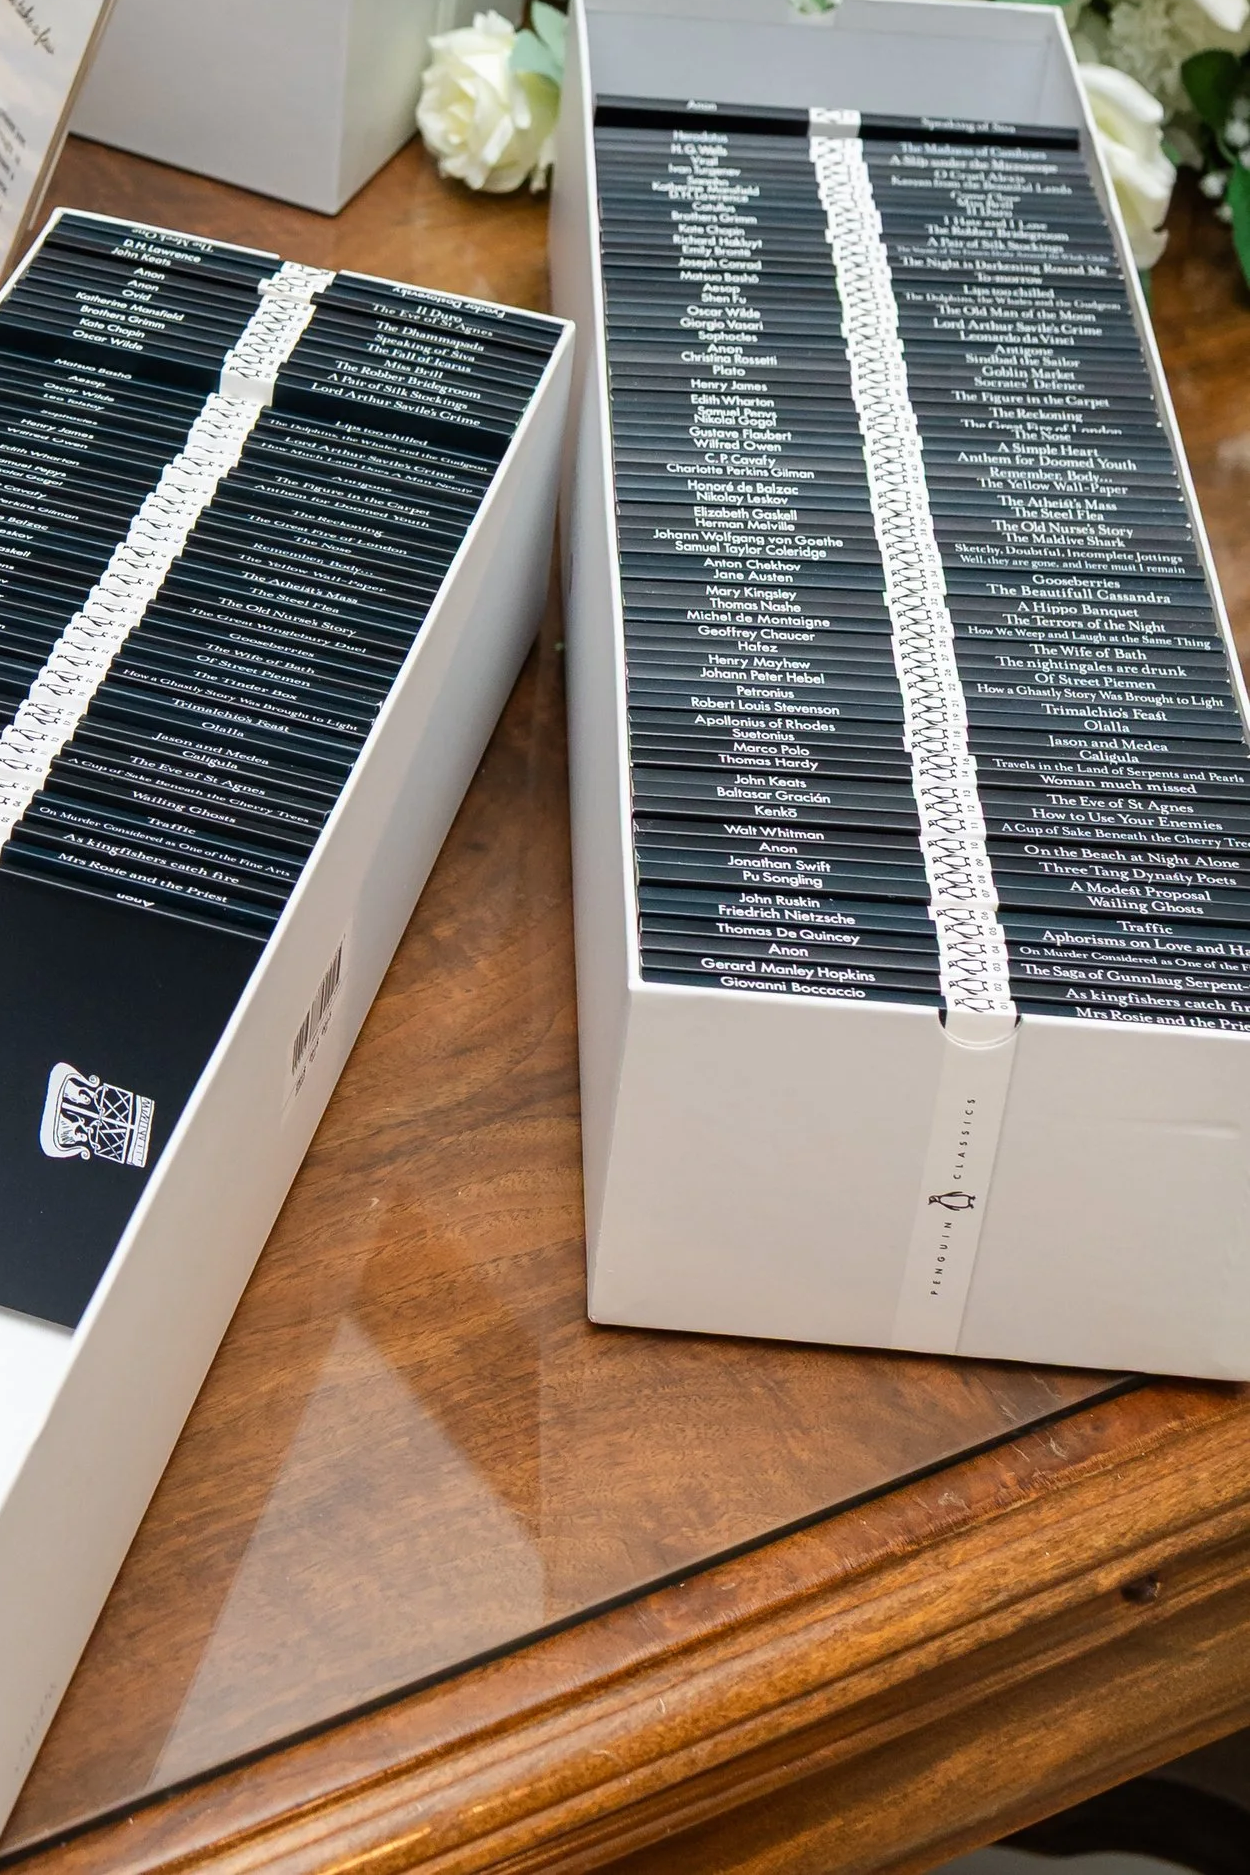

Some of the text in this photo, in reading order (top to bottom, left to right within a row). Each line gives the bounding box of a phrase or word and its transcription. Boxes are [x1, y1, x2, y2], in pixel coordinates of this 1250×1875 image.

[122, 289, 152, 301] Ovid
[76, 291, 184, 321] Katherine Mansfield
[687, 305, 761, 319] Oscar Wilde
[80, 305, 165, 330] Brothers Grimm
[79, 318, 145, 338] Kate Chopin
[73, 330, 143, 351] Oscar Wilde
[335, 360, 481, 399] The Robber Bridegroom
[311, 383, 343, 397] Lord
[344, 390, 392, 407] Arthur
[439, 410, 481, 426] Crime
[694, 506, 798, 521] Elizabeth Gaskell
[704, 558, 801, 572] Anton Chekhov
[698, 626, 815, 642] Geoffrey Chaucer
[737, 685, 795, 699] Petronius
[691, 697, 840, 716] Robert Louis Stevenson
[202, 721, 245, 738] Olalla
[695, 714, 835, 732] Apollonius of Rhodes
[732, 728, 795, 742] Suetonius
[733, 742, 810, 756] Marco Polo
[718, 754, 818, 772] Thomas Hardy
[734, 774, 807, 789] John Keats
[717, 787, 831, 804] Baltasar Gracián
[132, 790, 236, 824] Wailing Ghosts
[147, 816, 196, 835] Traffic
[723, 824, 824, 840] Walt Whitman
[759, 842, 798, 854] Anon
[1024, 844, 1240, 869] On the Beach at Night Alone
[63, 833, 239, 884] As kingfishers catch fire
[728, 855, 831, 872] Jonathan Swift
[58, 852, 228, 904] Mrs Rosie and the Priest
[743, 870, 823, 889] Pu Songling
[1039, 861, 1088, 875] Three
[1089, 865, 1130, 881] Tang
[1197, 873, 1237, 886] Poets
[739, 893, 820, 908] John Ruskin
[1070, 881, 1212, 902] A Modest Proposal
[718, 904, 856, 925] Friedrich Nietzsche
[1088, 895, 1204, 915] Wailing Ghosts
[716, 923, 860, 945] Thomas De Quincey
[1117, 920, 1173, 935] Traffic
[768, 943, 809, 957] Anon
[1042, 930, 1225, 955] Aphorisms on Love and
[701, 958, 876, 983] Gerard Manley Hopkins
[1021, 963, 1182, 990] The Saga of Gunnlaug
[721, 977, 866, 998] Giovanni Boccaccio
[1065, 988, 1227, 1010] As kingfishers catch
[1076, 1007, 1216, 1029] Mrs Rosie and the
[930, 1099, 976, 1296] PENGUIN CLASSICS
